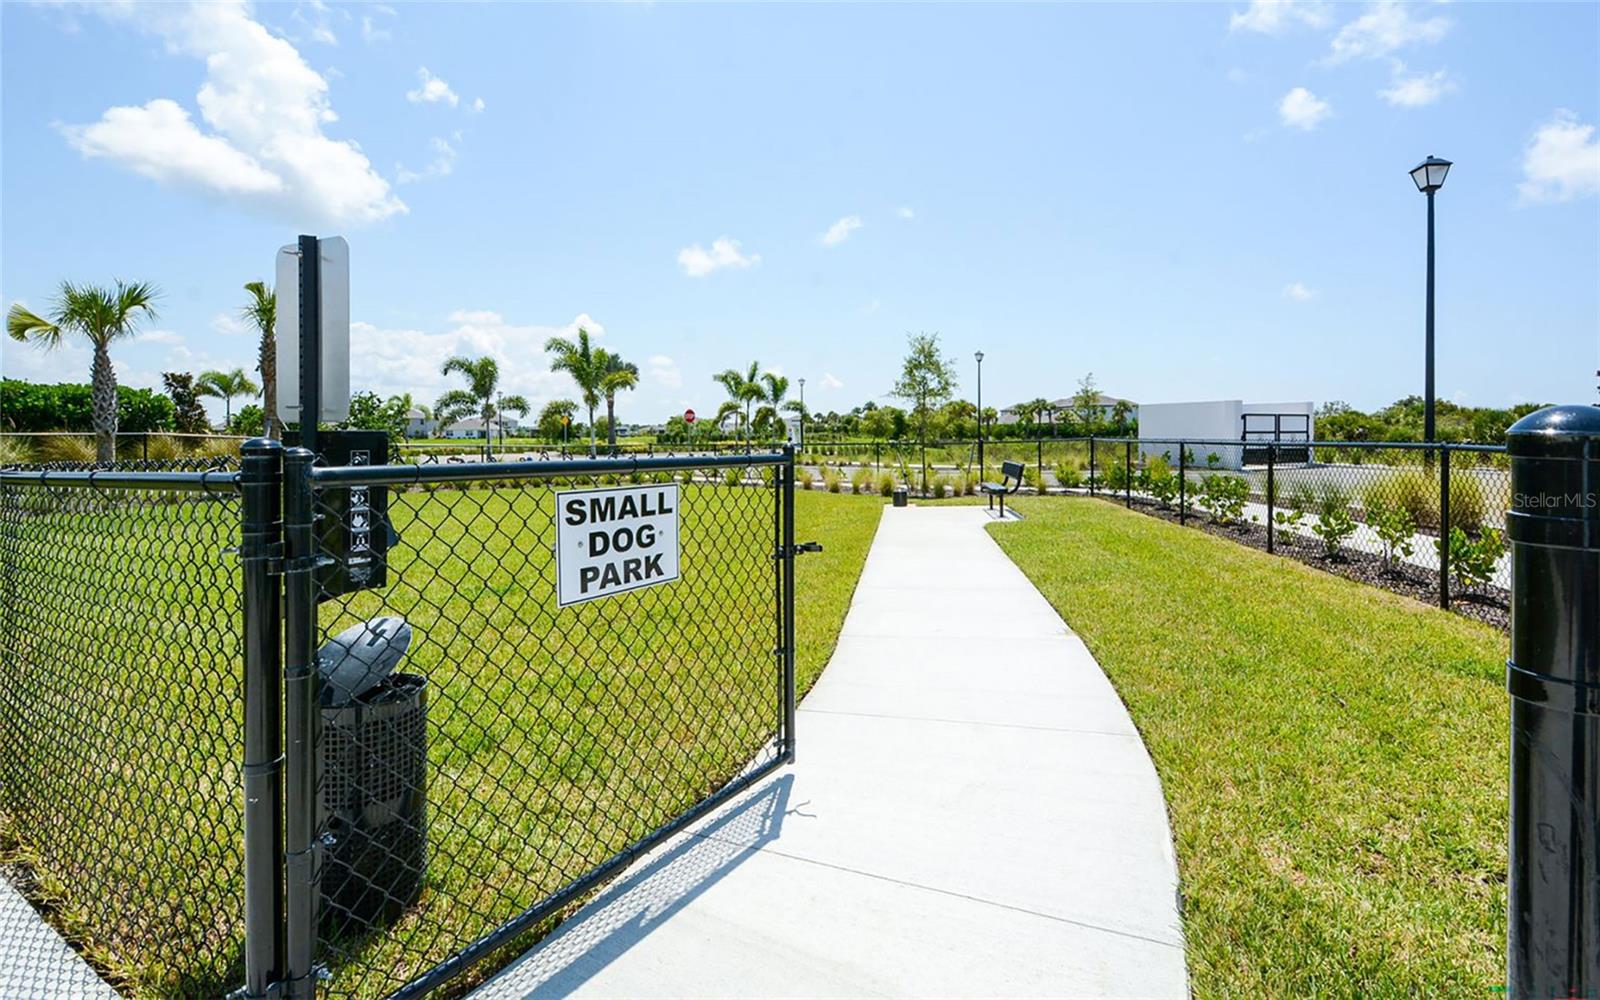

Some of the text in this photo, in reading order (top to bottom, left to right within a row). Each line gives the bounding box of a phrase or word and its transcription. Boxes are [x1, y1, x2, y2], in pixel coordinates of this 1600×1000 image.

[565, 492, 673, 526] SMALL
[589, 524, 656, 558] DOG
[580, 553, 664, 594] PARK
